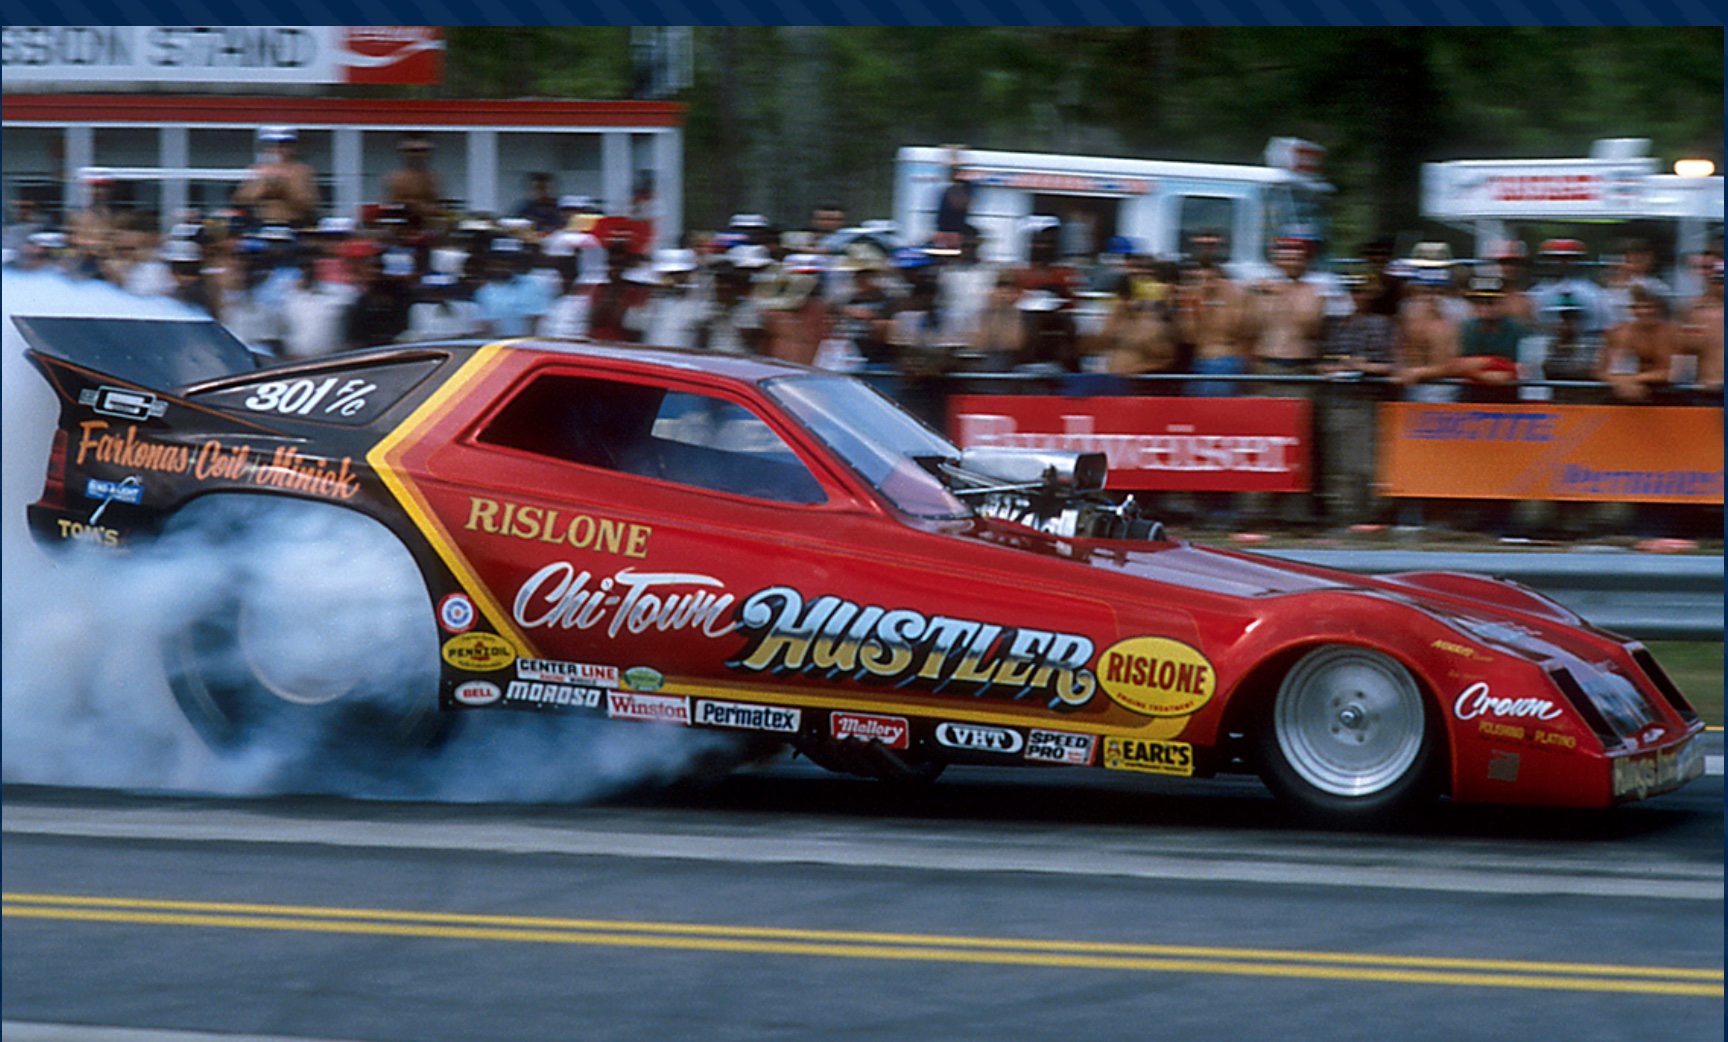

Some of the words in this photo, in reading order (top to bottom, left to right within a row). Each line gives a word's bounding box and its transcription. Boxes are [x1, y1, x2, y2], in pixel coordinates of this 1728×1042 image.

[153, 26, 317, 68] STAND
[245, 377, 338, 414] 301
[324, 379, 377, 417] F/C
[76, 420, 189, 473] Farkonas
[195, 439, 250, 480] Coil
[256, 446, 361, 498] Minick
[464, 497, 652, 558] RISLONE
[513, 562, 738, 638] Chi-Town
[742, 586, 1097, 706] HUSTLER
[519, 659, 577, 675] CENTER
[581, 666, 615, 681] LINE
[1107, 652, 1208, 695] RISLONE
[463, 688, 493, 698] BELL
[610, 694, 688, 719] Winston
[1454, 682, 1563, 720] Crown
[703, 702, 796, 730] Permatex
[838, 717, 905, 739] Mallory
[952, 727, 1006, 749] VHT
[1031, 731, 1090, 749] SPEED
[1028, 744, 1066, 760] PRO
[1122, 740, 1190, 766] EARL'S
